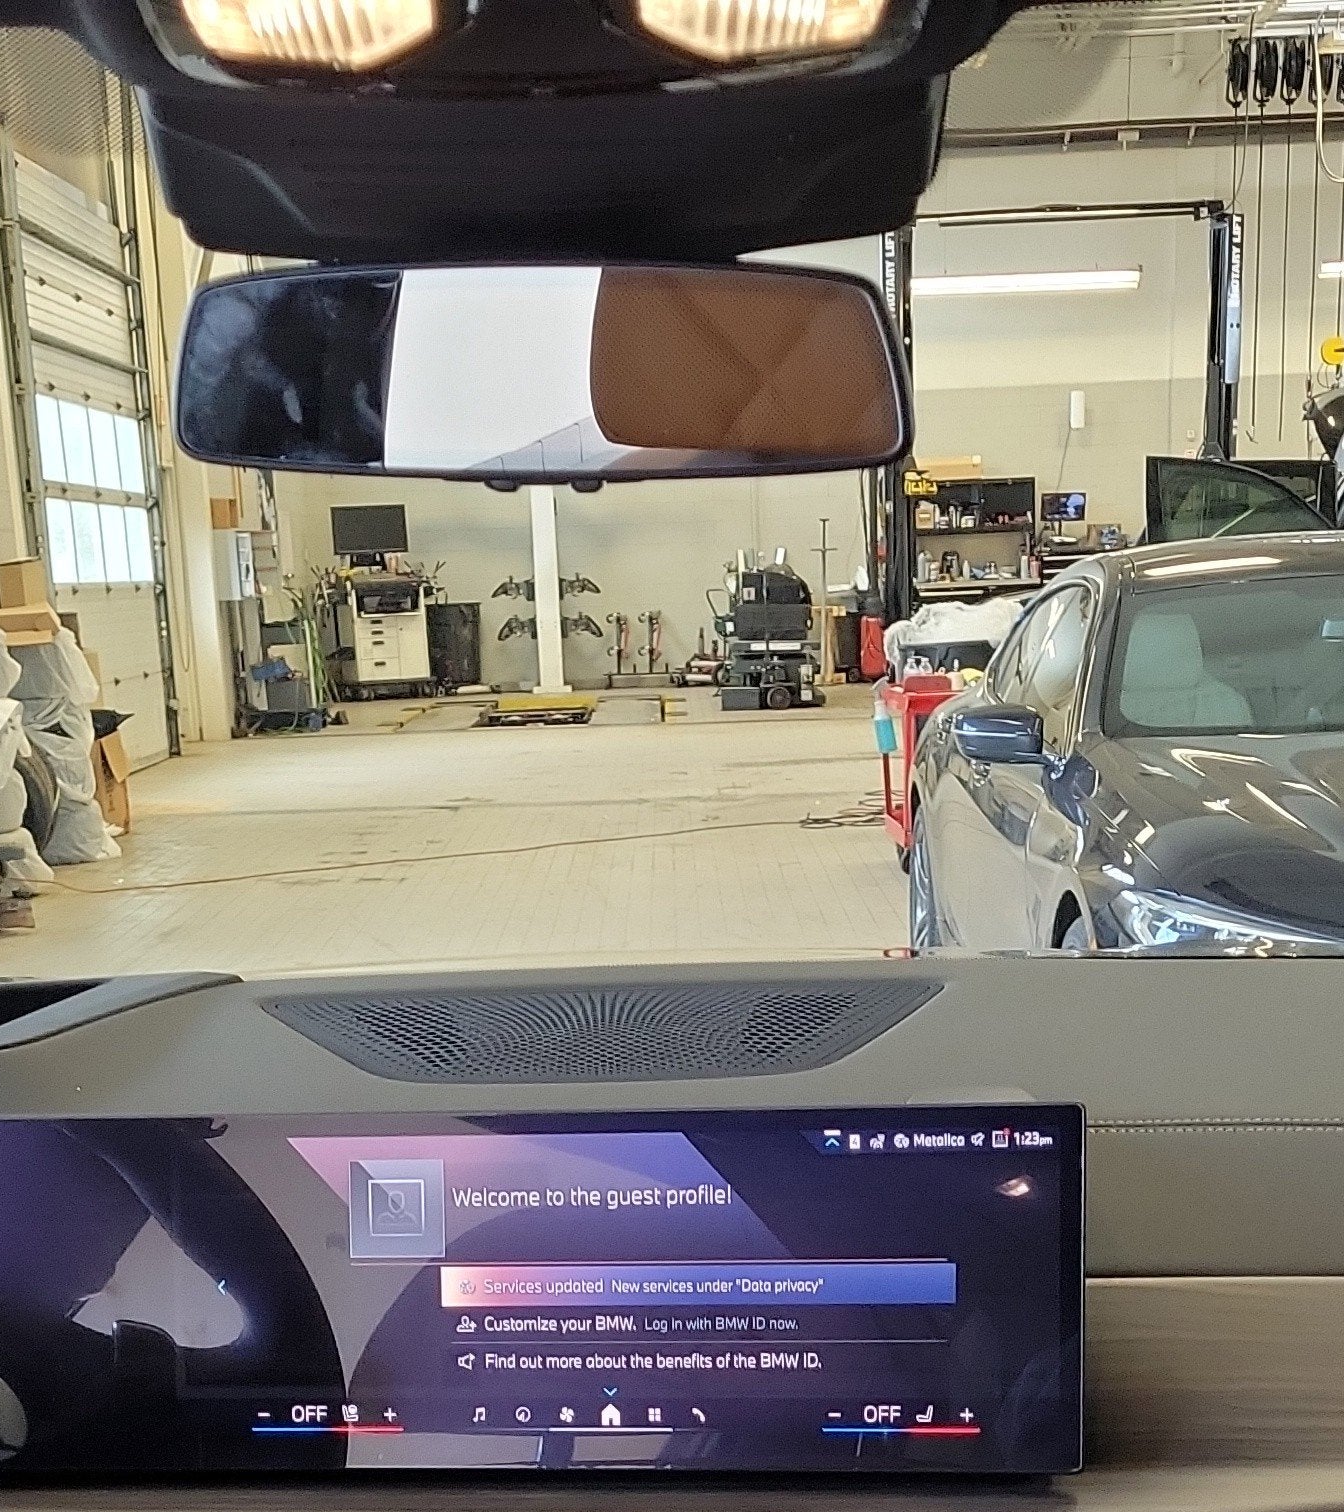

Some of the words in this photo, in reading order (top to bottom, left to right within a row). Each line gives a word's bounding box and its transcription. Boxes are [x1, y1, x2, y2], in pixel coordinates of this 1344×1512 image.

[884, 231, 896, 258] LIFT
[452, 1187, 540, 1208] Welcome
[546, 1188, 564, 1206] to
[570, 1186, 601, 1206] the
[606, 1186, 661, 1210] guest
[666, 1184, 733, 1209] profile!
[483, 1279, 543, 1294] Services
[546, 1279, 603, 1297] updated
[611, 1280, 639, 1293] New
[643, 1279, 693, 1293] services
[696, 1279, 733, 1293] under
[735, 1277, 772, 1293] "Data
[774, 1277, 824, 1295] privacy"
[484, 1315, 557, 1332] Customize
[560, 1317, 593, 1334] your
[595, 1315, 637, 1331] BMW.
[644, 1316, 668, 1334] Log
[671, 1317, 682, 1331] in
[685, 1316, 712, 1331] with
[715, 1316, 749, 1331] BMW
[752, 1316, 766, 1330] ID
[769, 1318, 799, 1331] now.
[484, 1353, 516, 1369] Find
[519, 1355, 543, 1369] out
[546, 1355, 582, 1369] more
[585, 1353, 627, 1369] about
[630, 1353, 653, 1369] the
[656, 1352, 713, 1369] benefits
[716, 1352, 732, 1369] of
[733, 1352, 757, 1368] the
[760, 1352, 799, 1368] BMW
[803, 1352, 822, 1369] ID.
[290, 1405, 328, 1422] OFF
[863, 1405, 902, 1422] OFF
